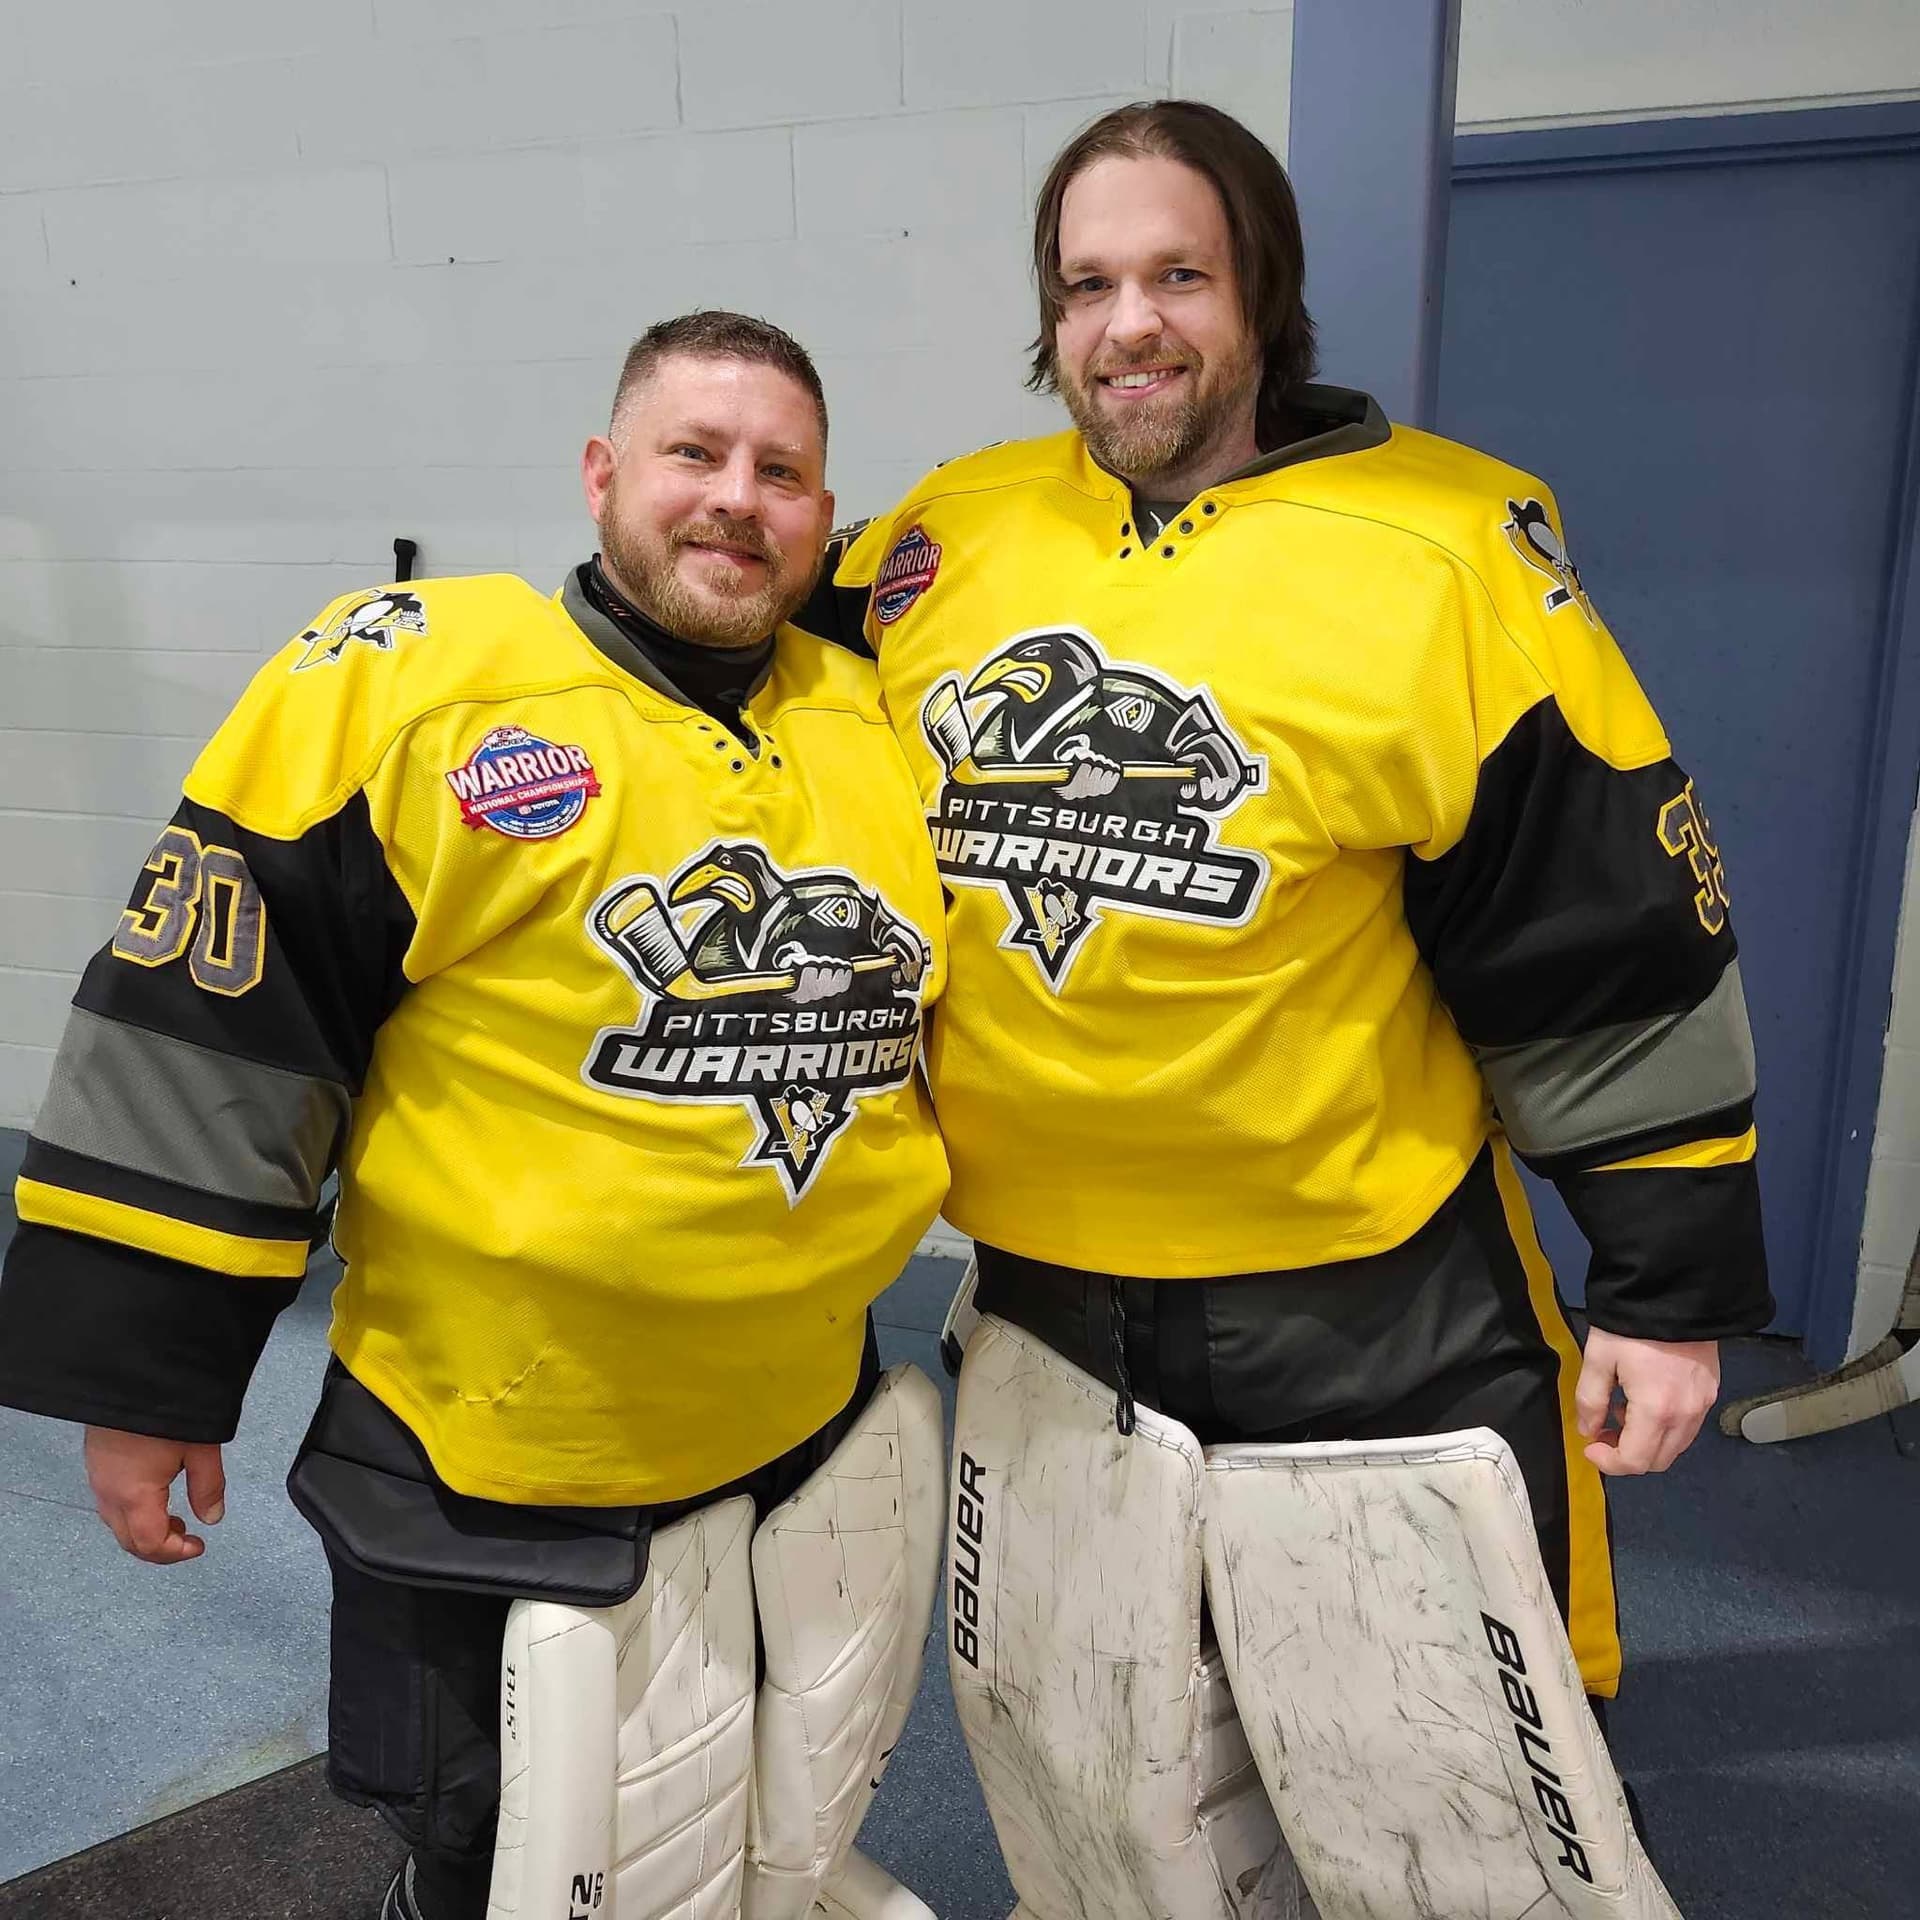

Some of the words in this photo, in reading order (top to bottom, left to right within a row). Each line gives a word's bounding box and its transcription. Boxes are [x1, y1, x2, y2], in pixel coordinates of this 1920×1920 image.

[449, 746, 592, 800] WARRIOR
[469, 793, 517, 815] NATIONAL
[518, 776, 590, 801] CHAMPIONSHIPS
[947, 798, 1197, 850] PITTSBURGH
[931, 825, 1244, 905] WARRIORS
[111, 825, 267, 998] 30
[662, 1006, 908, 1038] PITTSBURGH
[610, 1035, 917, 1083] WARRIORS
